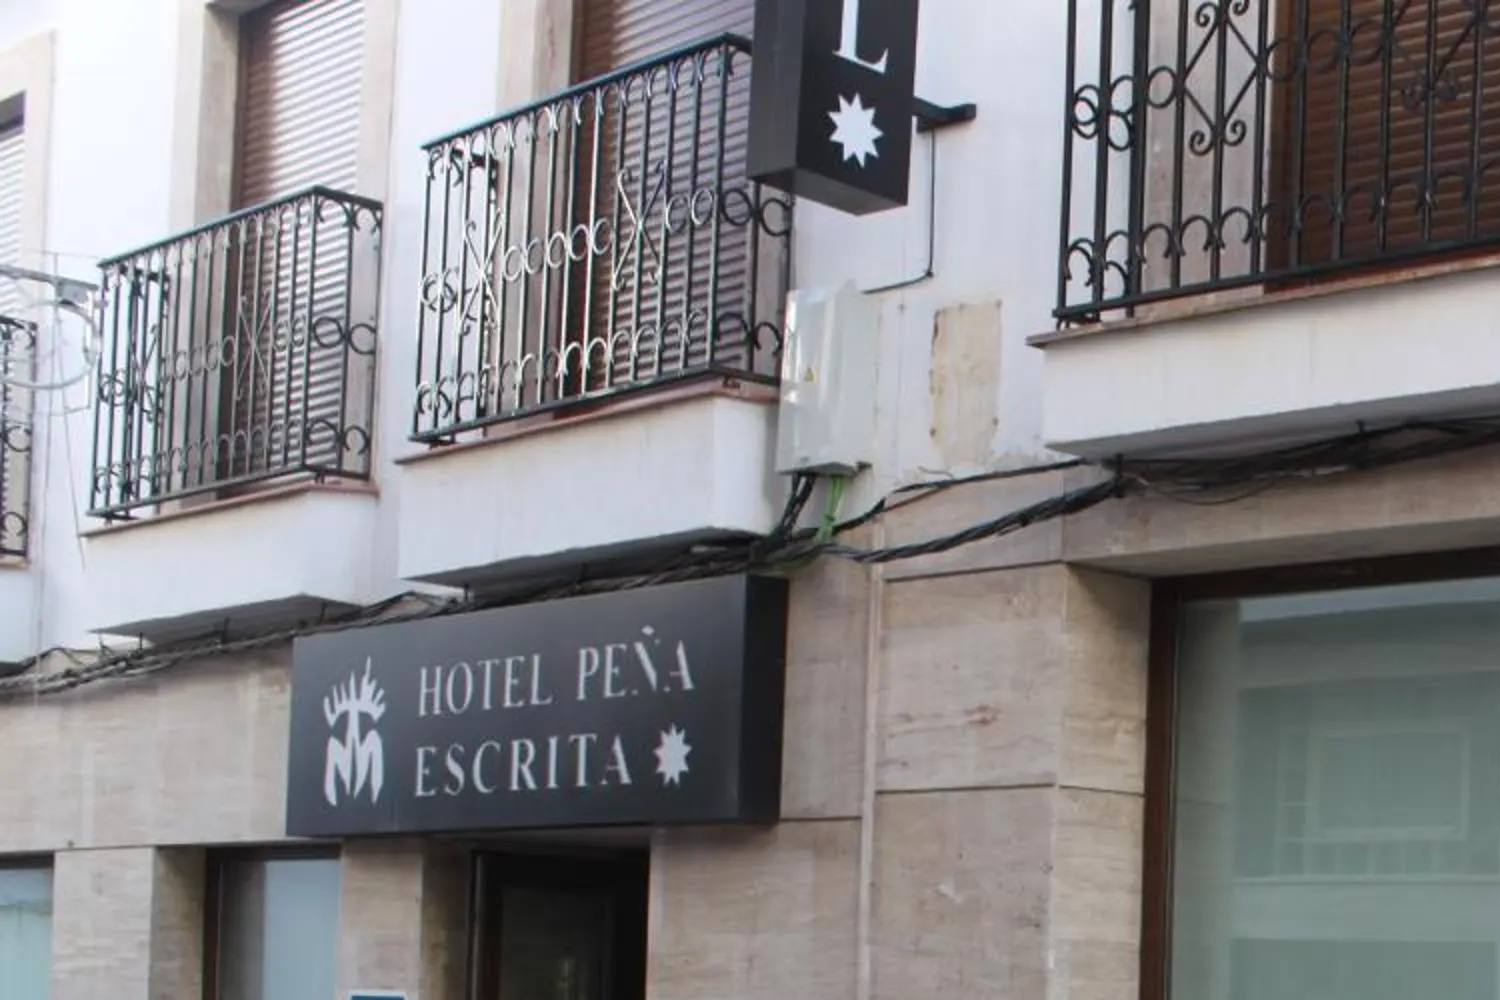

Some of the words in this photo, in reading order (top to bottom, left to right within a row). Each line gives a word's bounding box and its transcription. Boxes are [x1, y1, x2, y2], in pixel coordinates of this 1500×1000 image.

[832, 0, 889, 74] L
[418, 653, 553, 718] HOTEL
[575, 624, 696, 701] PEÑA
[415, 732, 632, 798] ESCRITA
